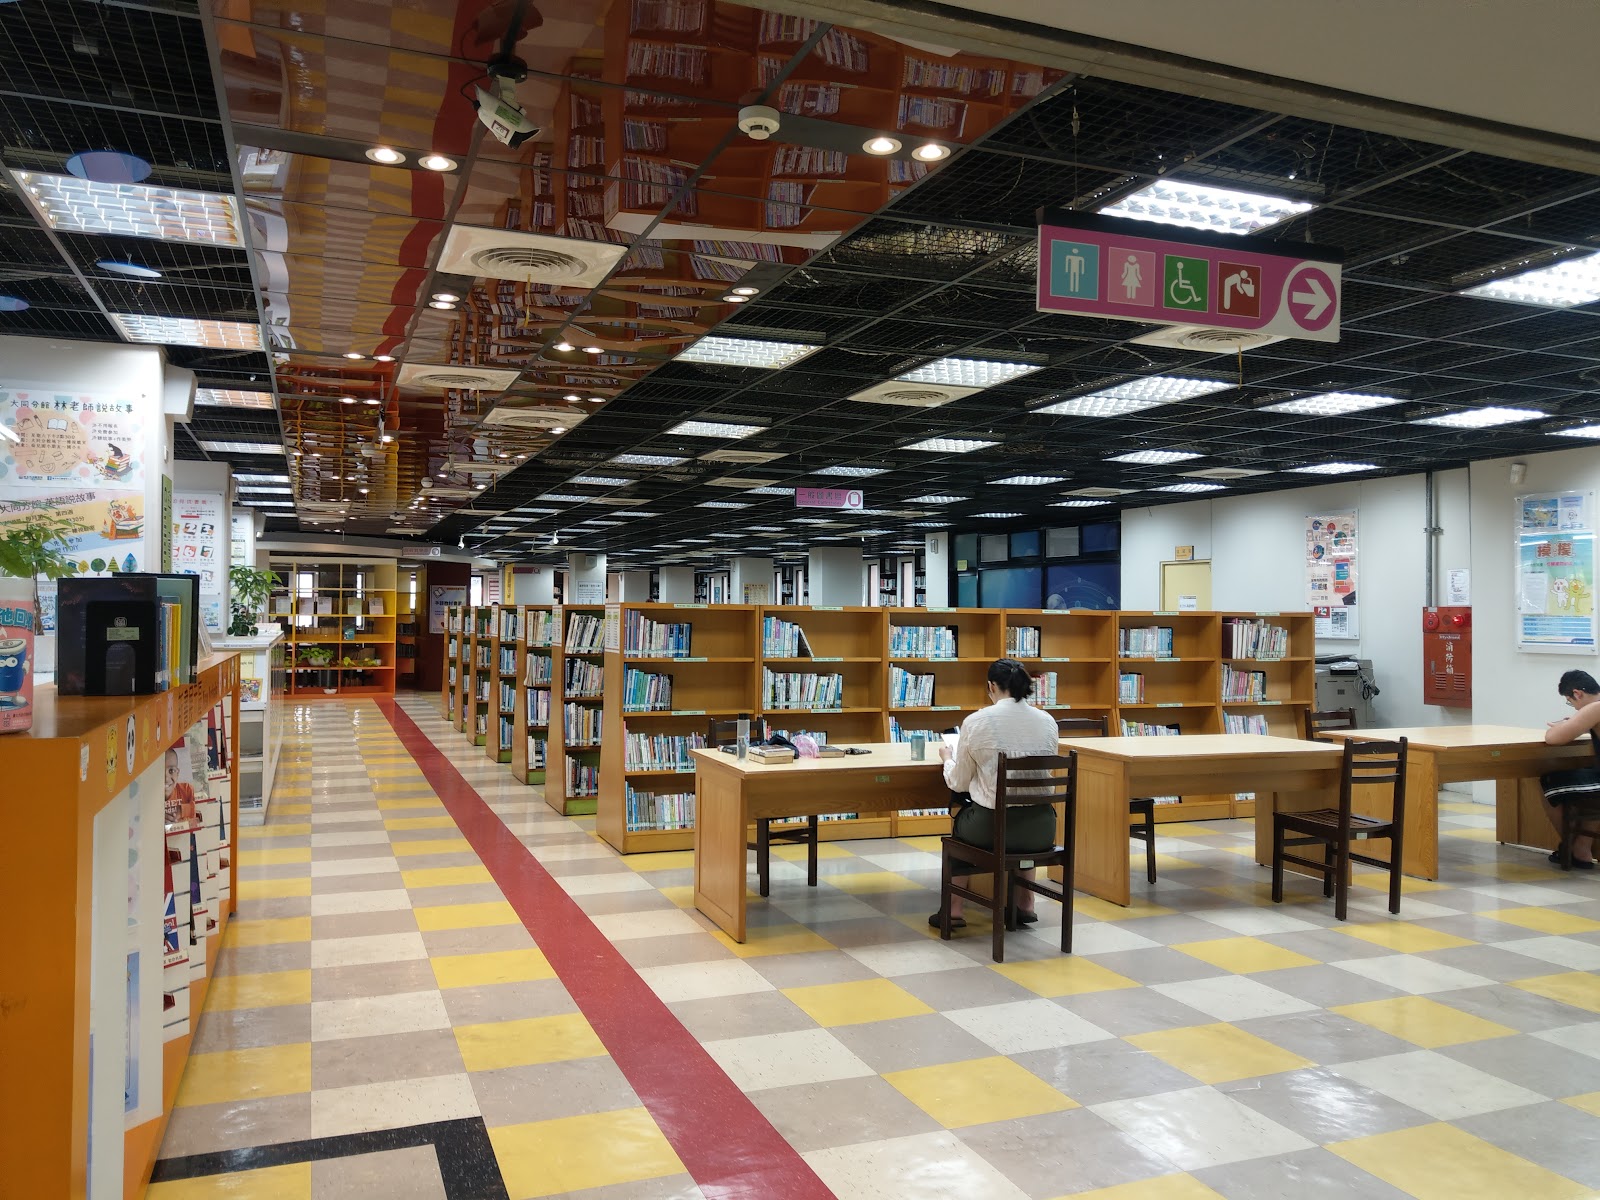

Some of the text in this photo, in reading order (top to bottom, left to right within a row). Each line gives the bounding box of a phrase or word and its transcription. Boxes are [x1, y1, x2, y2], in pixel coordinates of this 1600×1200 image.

[10, 399, 51, 409] 大同分館
[1445, 641, 1455, 675] 消防箱
